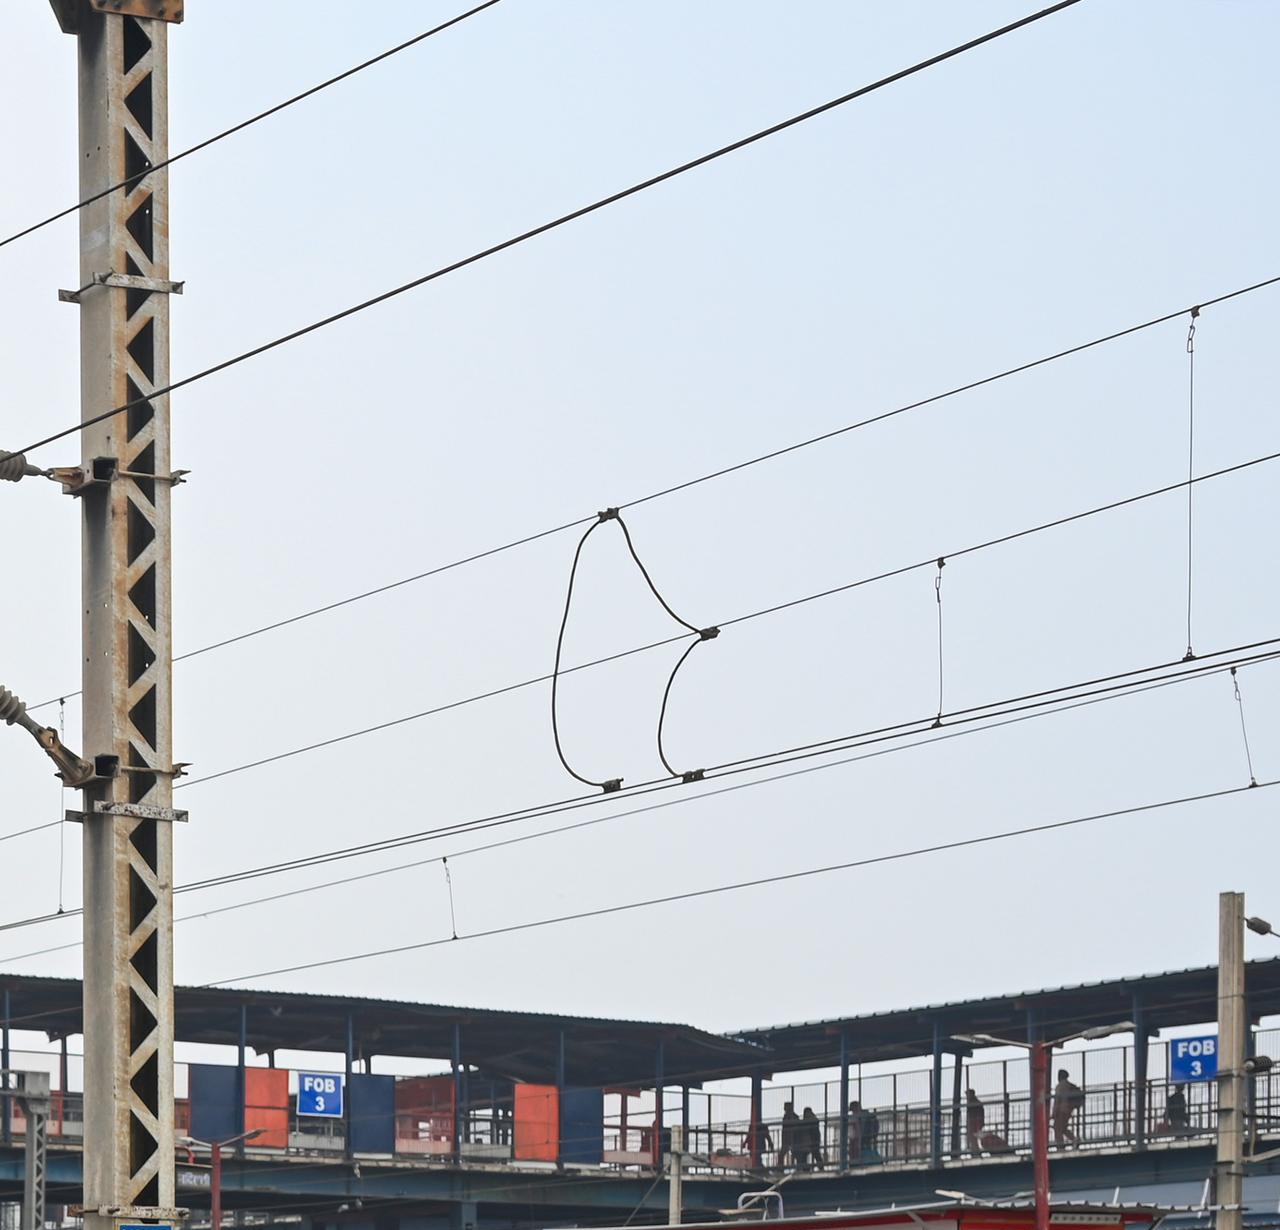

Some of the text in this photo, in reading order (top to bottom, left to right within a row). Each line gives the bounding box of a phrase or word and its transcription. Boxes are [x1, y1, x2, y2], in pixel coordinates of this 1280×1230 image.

[1178, 1039, 1215, 1058] FOB
[1191, 1060, 1202, 1077] 3
[304, 1077, 336, 1093] FOB
[315, 1096, 325, 1111] 3
